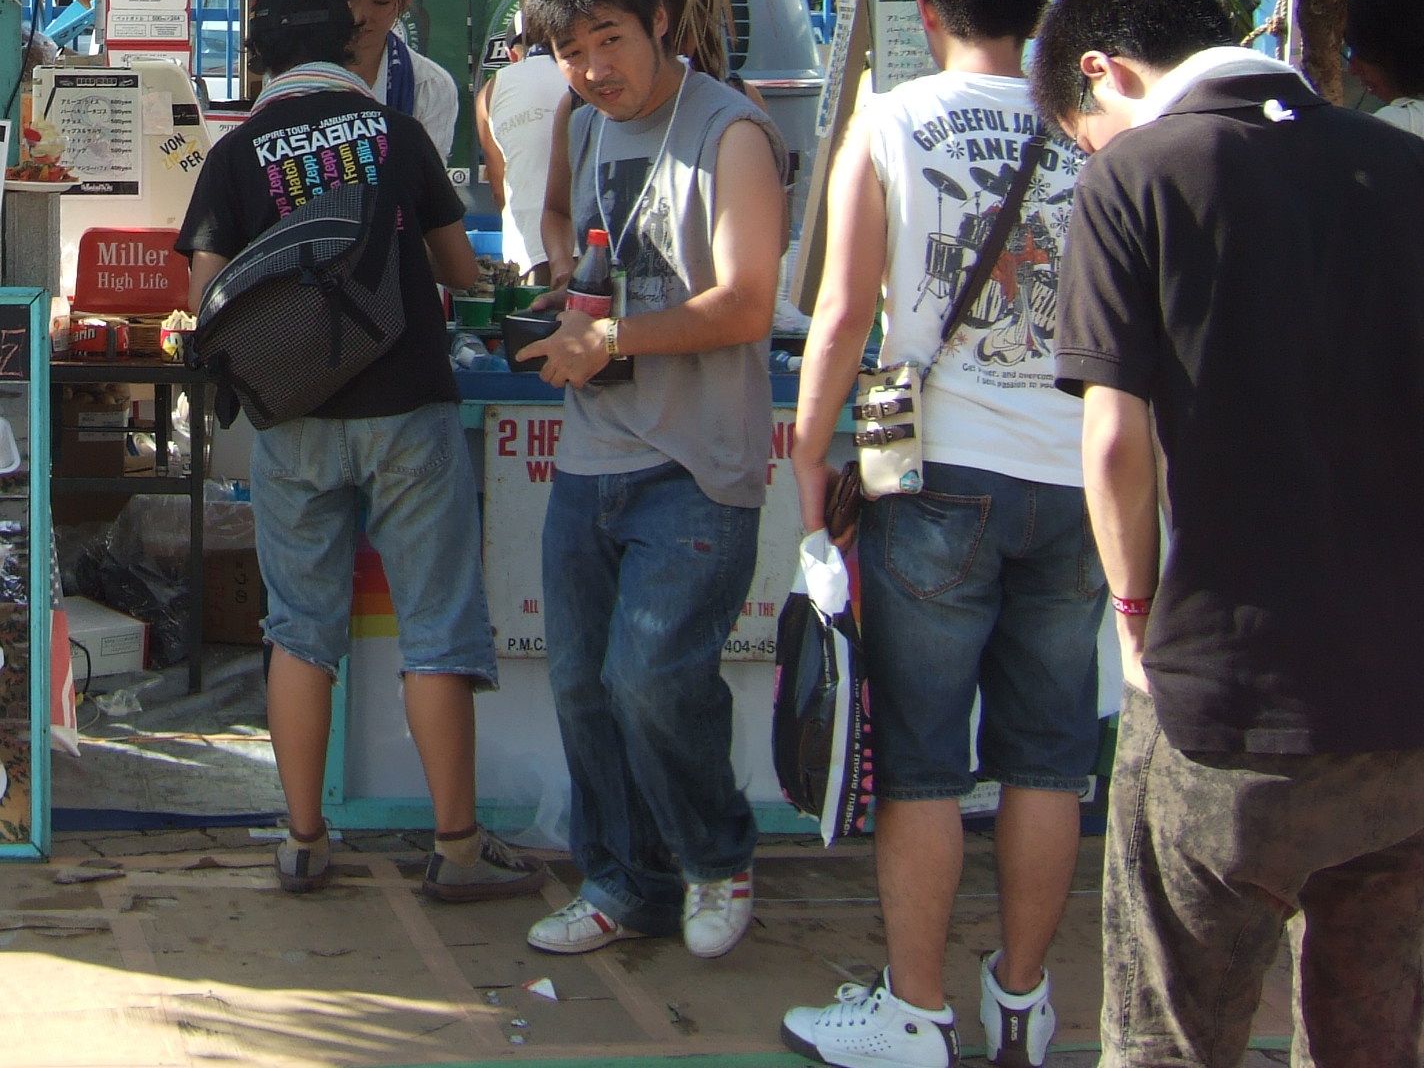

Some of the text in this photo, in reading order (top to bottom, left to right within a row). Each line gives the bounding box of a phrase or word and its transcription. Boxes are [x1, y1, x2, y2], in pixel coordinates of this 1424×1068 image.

[160, 133, 186, 155] VON
[252, 128, 285, 147] EMPIRE
[286, 124, 310, 136] TOUR
[319, 113, 359, 129] JANUARY
[256, 117, 388, 167] KASABIAN
[913, 108, 1009, 151] GRACEFUL
[180, 151, 204, 172] PER
[320, 150, 339, 180] Zepp
[339, 143, 358, 180] Forum
[357, 139, 374, 164] Blitz
[267, 164, 284, 196] Zepp
[282, 158, 304, 196] Hatch
[303, 155, 321, 186] Zepp
[97, 242, 169, 266] Miller
[98, 272, 168, 292] High Life
[499, 420, 517, 456] 2
[523, 600, 539, 613] ALL
[757, 602, 774, 616] THE
[508, 638, 546, 651] P.M.C.
